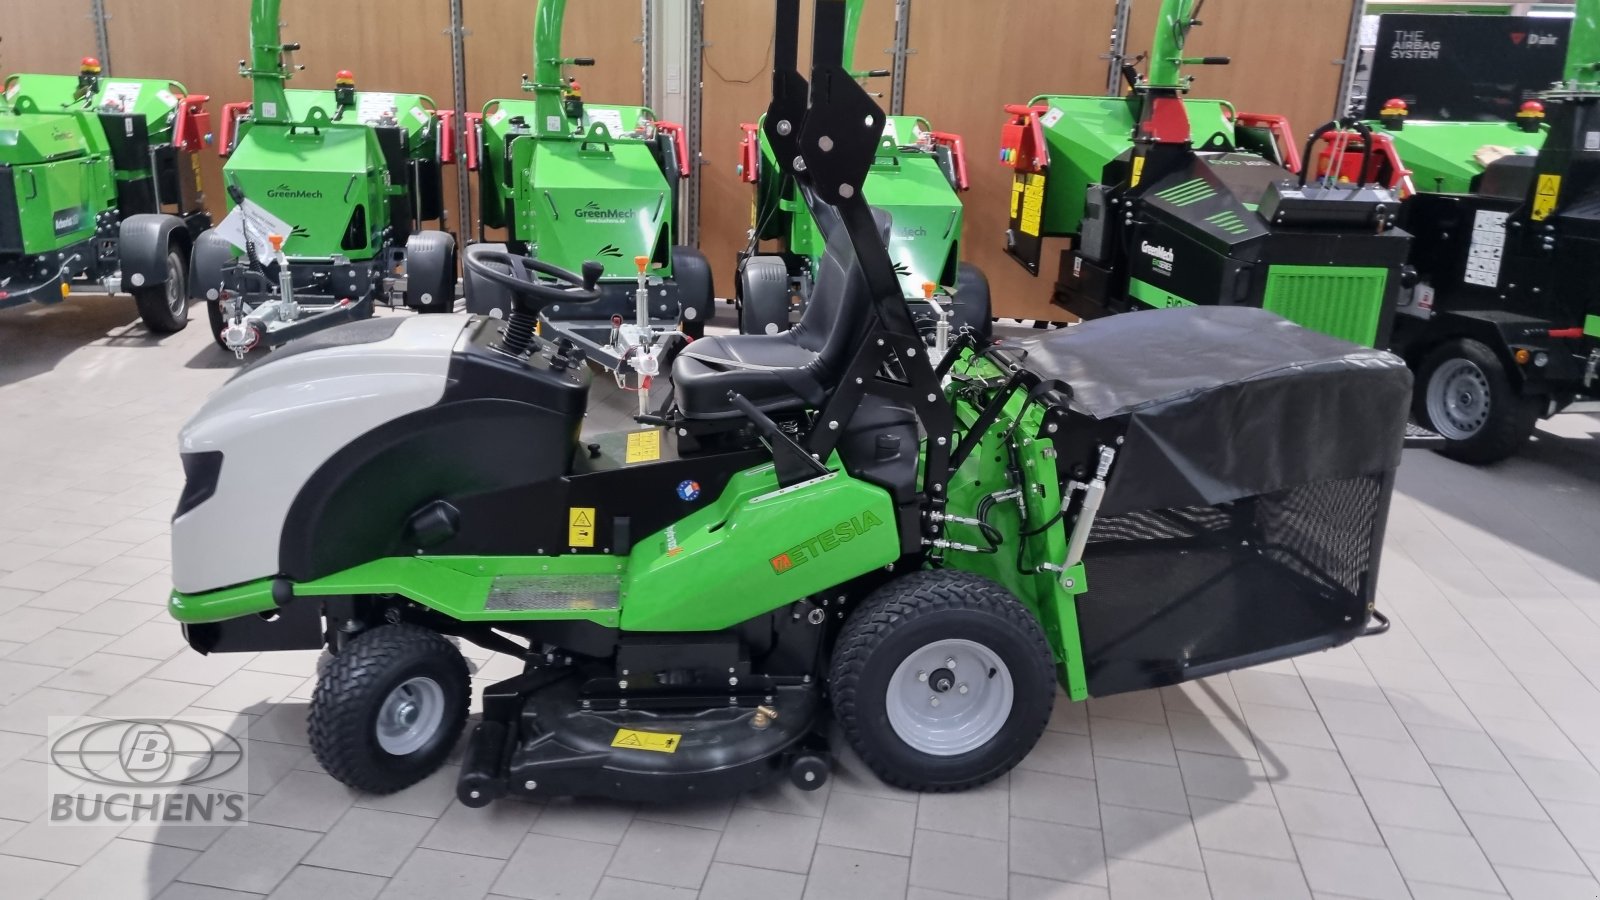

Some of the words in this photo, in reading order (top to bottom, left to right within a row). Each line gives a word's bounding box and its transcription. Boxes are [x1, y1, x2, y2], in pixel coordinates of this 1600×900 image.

[1395, 31, 1424, 42] THE
[1392, 41, 1441, 50] AIRBAG
[1391, 50, 1439, 59] SYSTEM
[267, 189, 323, 199] GreenMech
[574, 208, 637, 218] GreenMech
[1141, 240, 1174, 262] GreenMech
[790, 510, 884, 565] ETESIA
